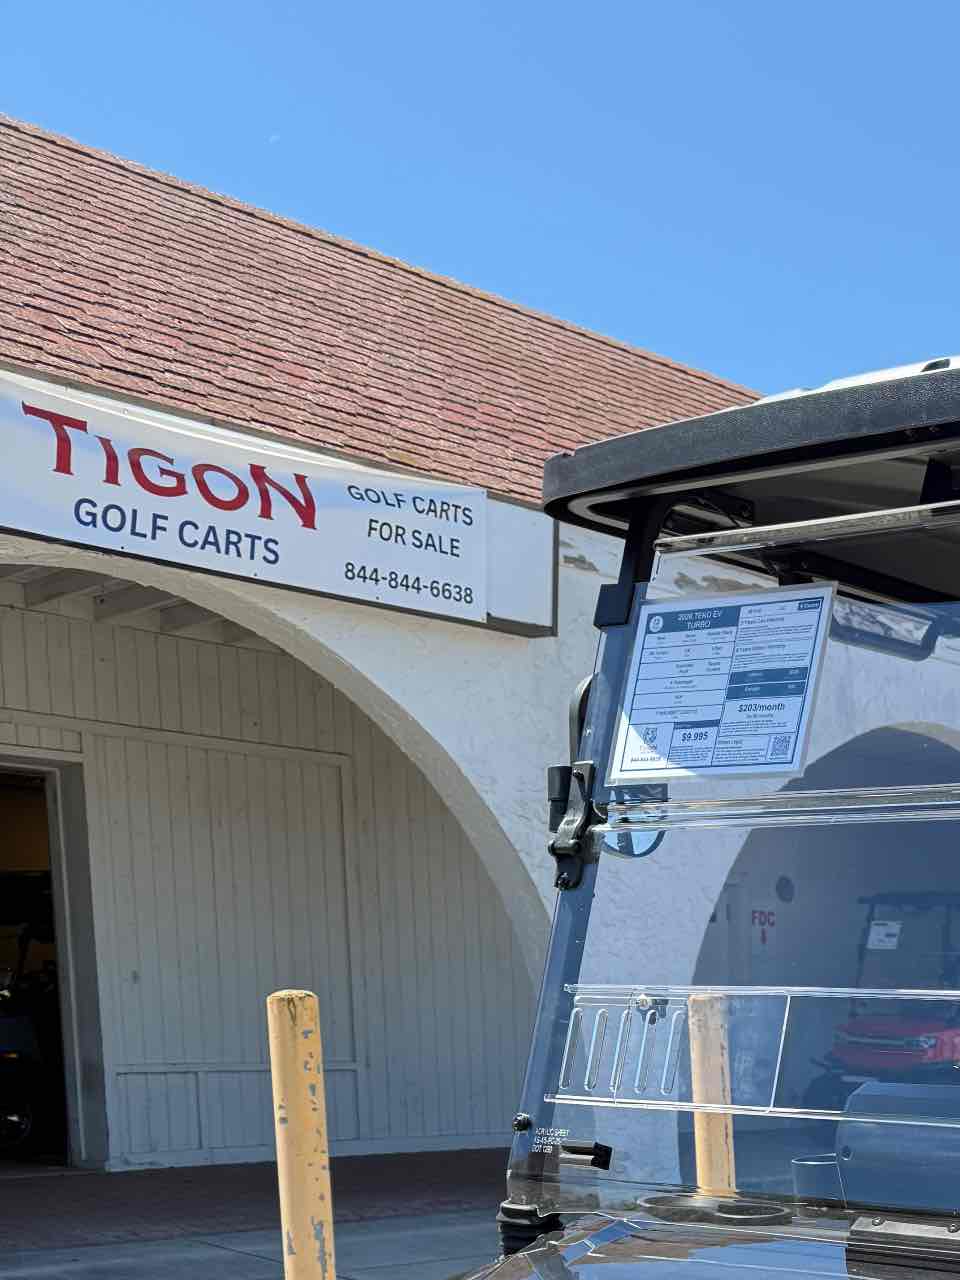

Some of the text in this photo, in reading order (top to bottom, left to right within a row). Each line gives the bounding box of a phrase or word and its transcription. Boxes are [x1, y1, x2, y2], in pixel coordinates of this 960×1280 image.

[21, 400, 317, 530] TIGON
[347, 484, 474, 526] GOLF CARTS
[73, 497, 281, 565] GOLF CARTS
[367, 518, 461, 558] FOR SALE
[344, 561, 474, 605] 844-844-6638
[751, 909, 776, 927] FDC
